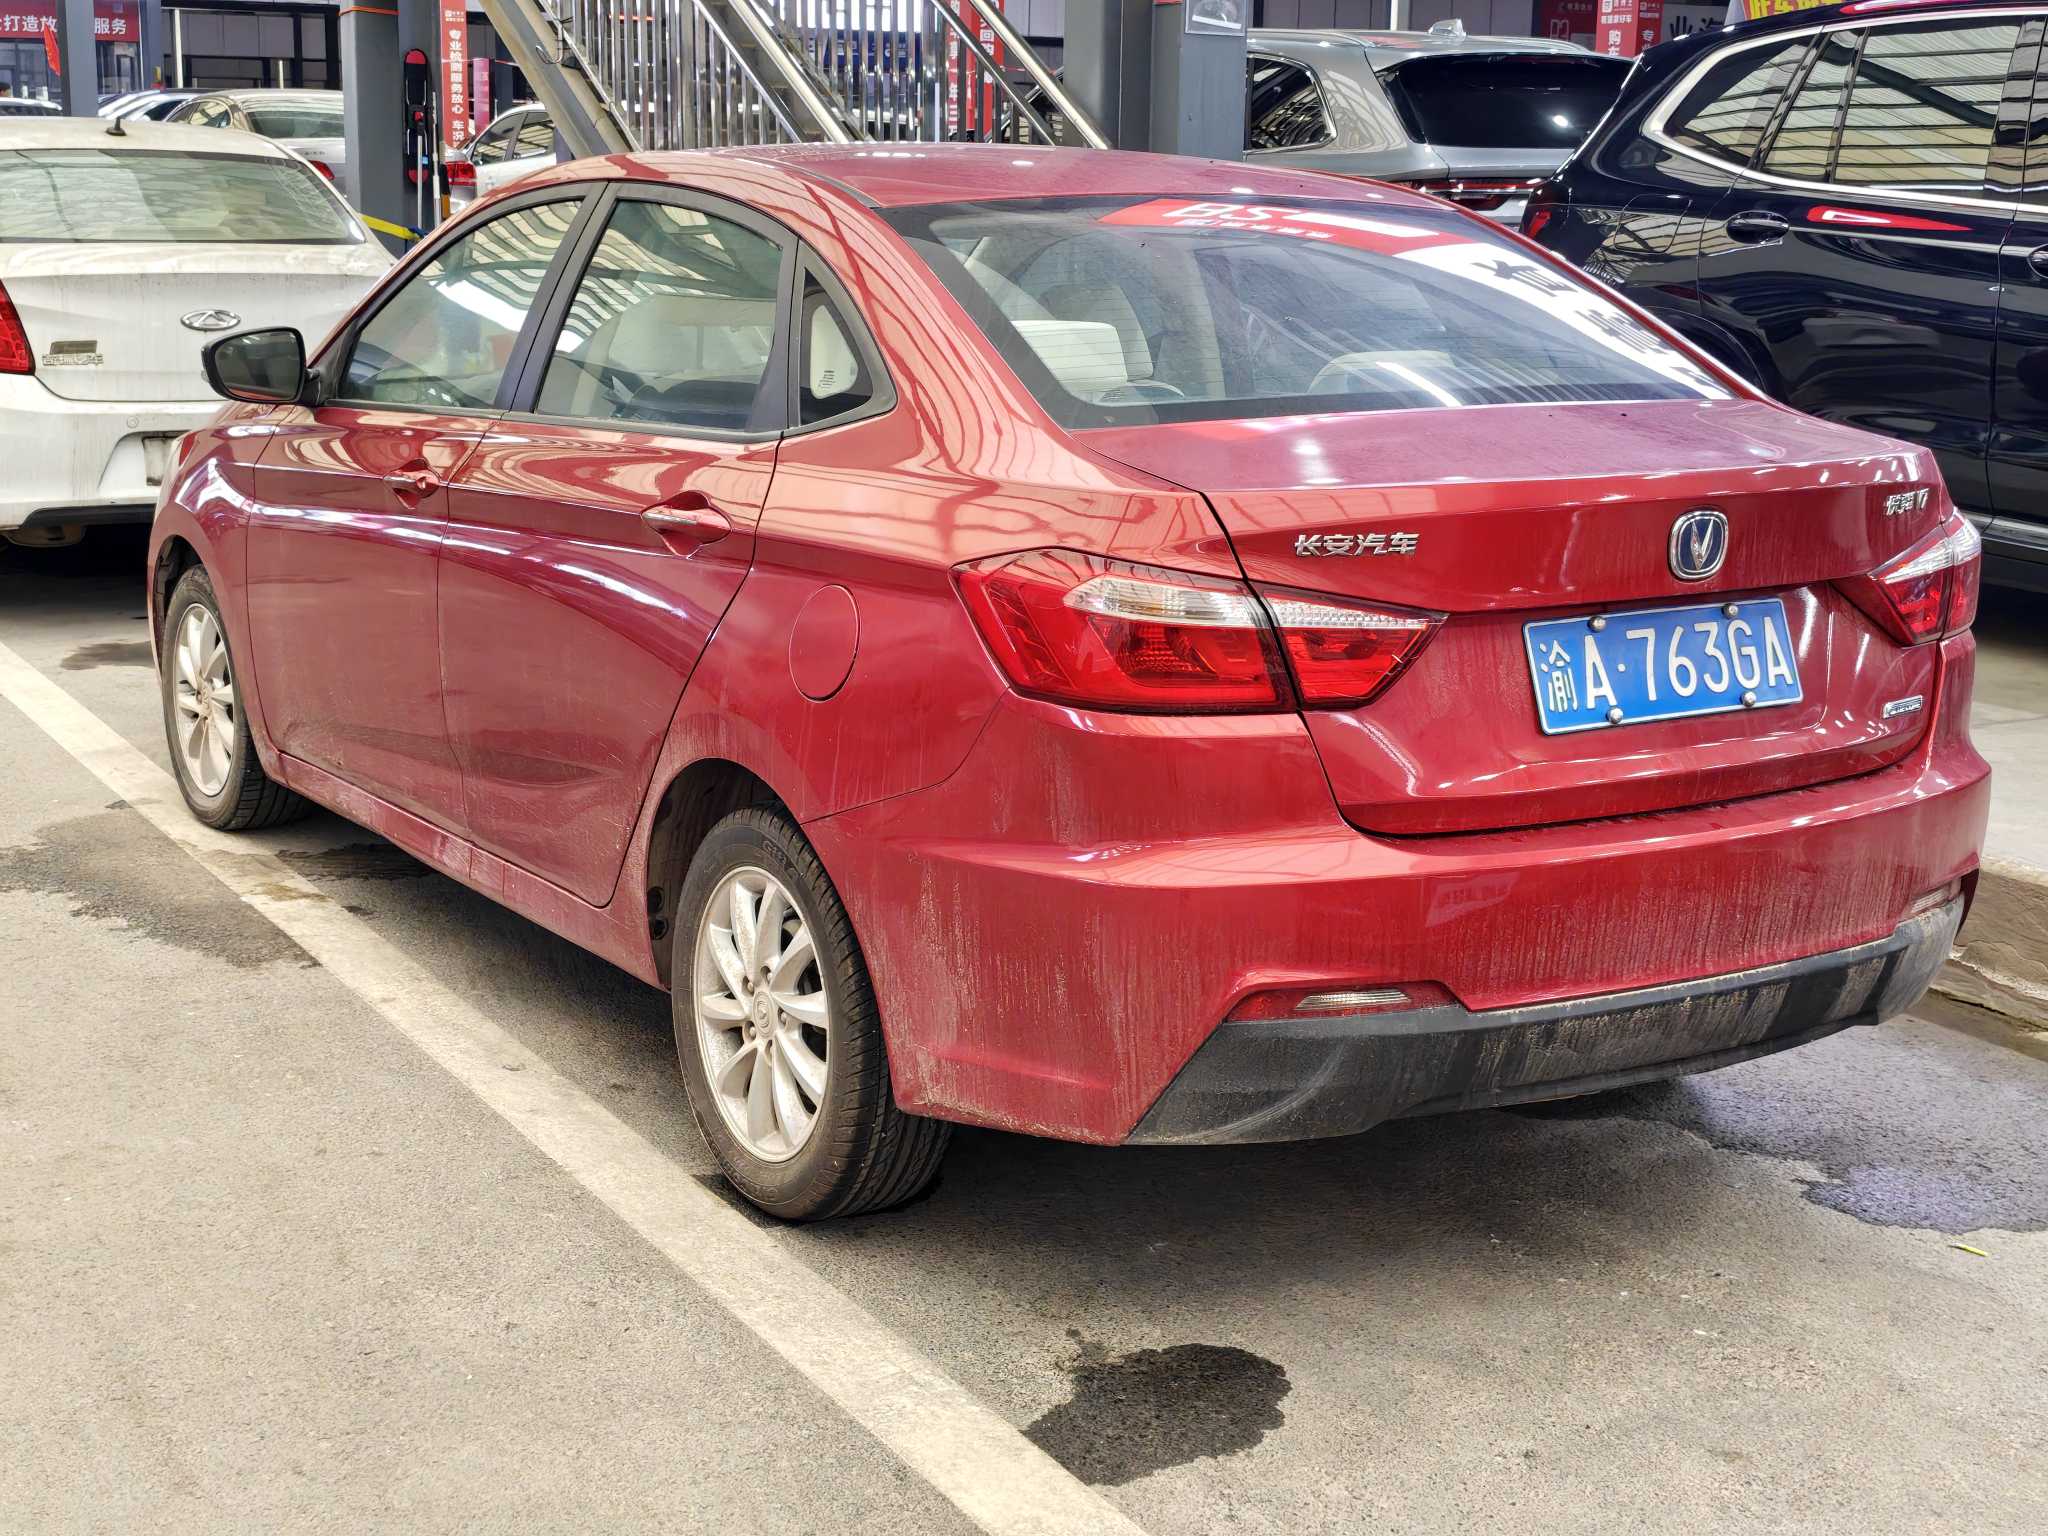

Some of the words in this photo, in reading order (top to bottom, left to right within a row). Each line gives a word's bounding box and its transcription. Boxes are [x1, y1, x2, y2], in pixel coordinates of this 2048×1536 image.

[0, 14, 58, 33] 打造放
[94, 17, 127, 35] 服务
[1294, 532, 1420, 557] 长安汽车
